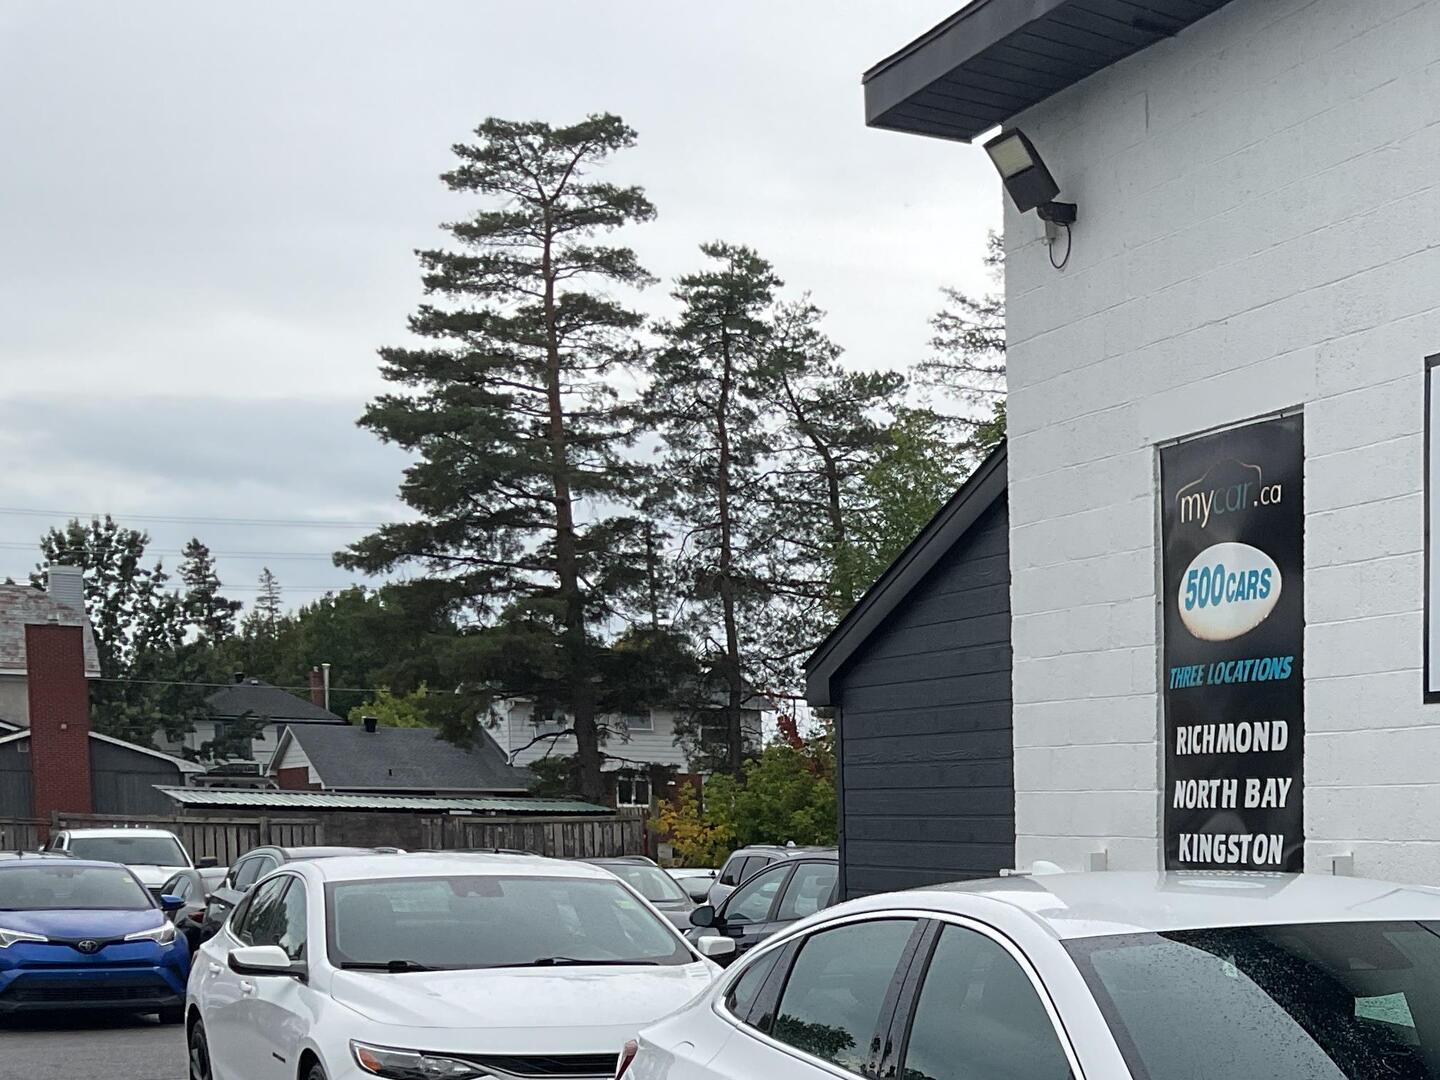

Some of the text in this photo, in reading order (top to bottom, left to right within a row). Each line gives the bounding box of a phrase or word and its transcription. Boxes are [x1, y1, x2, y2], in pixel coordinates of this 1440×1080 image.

[1169, 655, 1294, 690] THREE LOCATIONS
[1175, 720, 1289, 756] RICHMOND
[1172, 777, 1293, 809] NORTH BAY
[1178, 833, 1284, 865] KINGSTON
